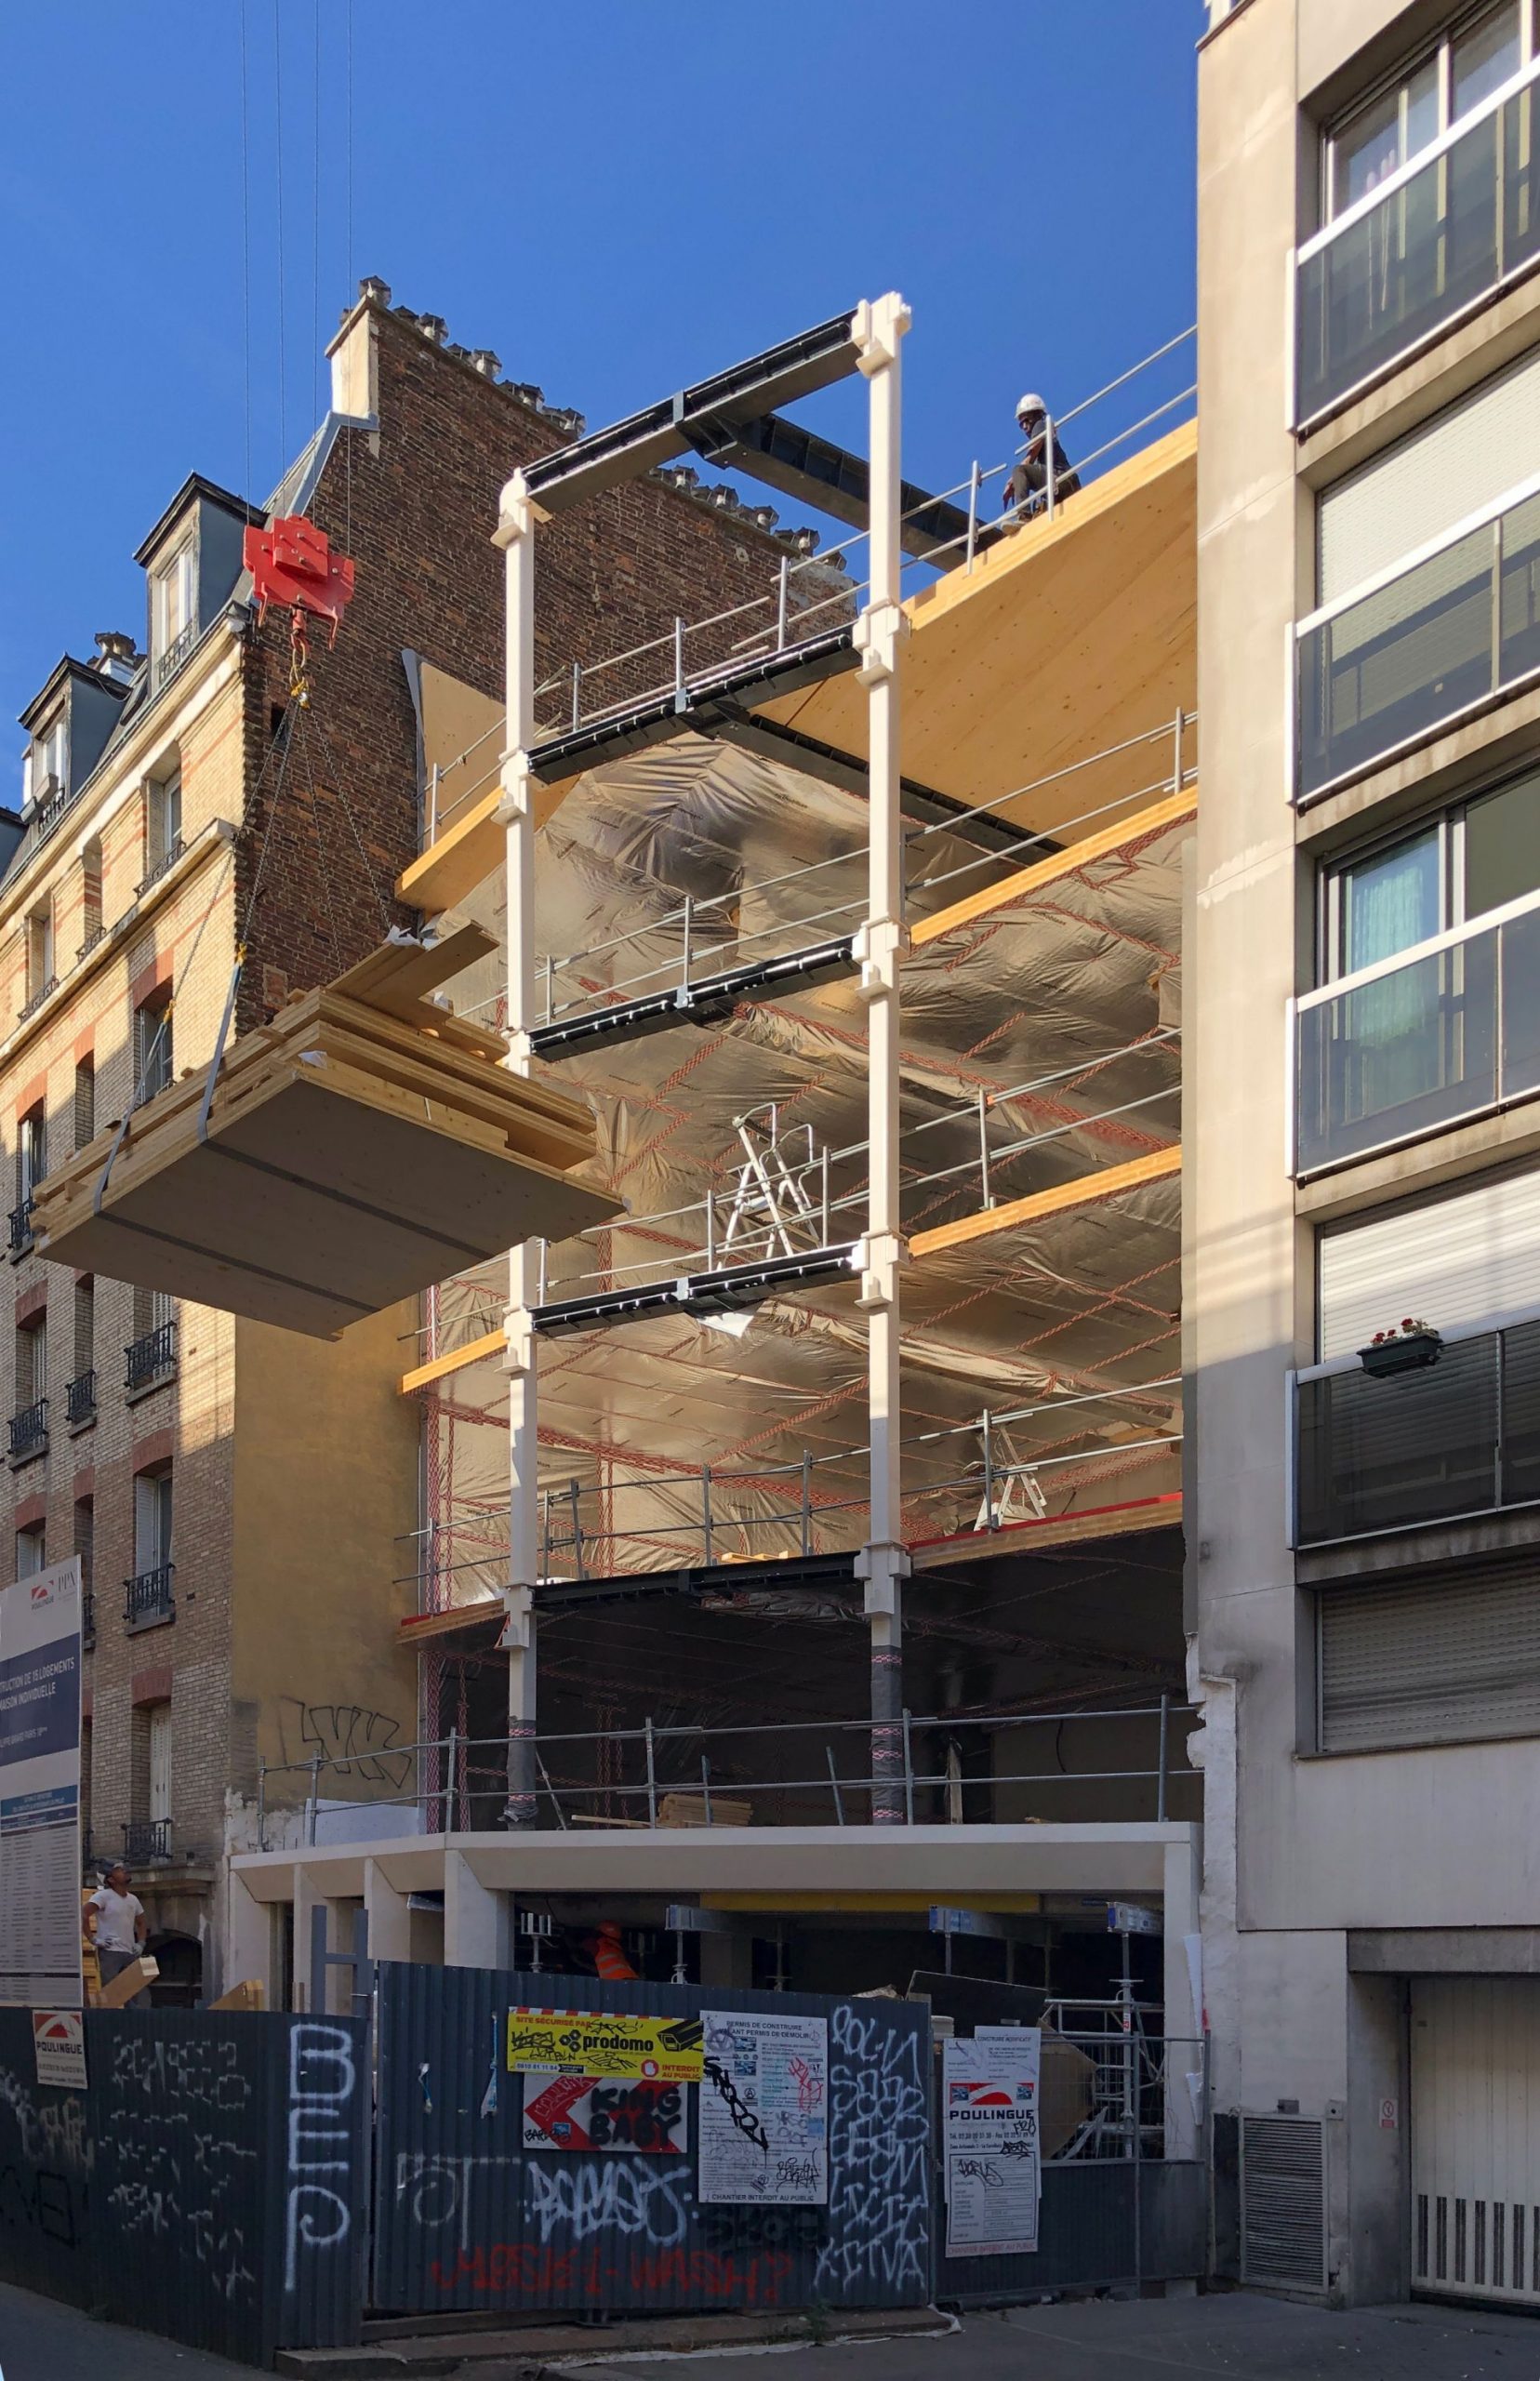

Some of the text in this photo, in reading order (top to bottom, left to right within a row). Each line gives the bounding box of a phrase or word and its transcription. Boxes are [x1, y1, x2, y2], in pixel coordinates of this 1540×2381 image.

[515, 2015, 534, 2024] SITE
[726, 2020, 750, 2029] PERMIS
[763, 2022, 803, 2031] CONSTRUIRE
[36, 2041, 83, 2055] POULINGUE
[582, 2034, 654, 2053] prodomo
[661, 2064, 700, 2073] INTERDIT
[591, 2086, 682, 2115] KING
[949, 2109, 1035, 2121] POULINGUE
[711, 2193, 747, 2201] CHANTIER
[748, 2193, 777, 2201] INTERDIT
[790, 2194, 815, 2202] PUBLIC
